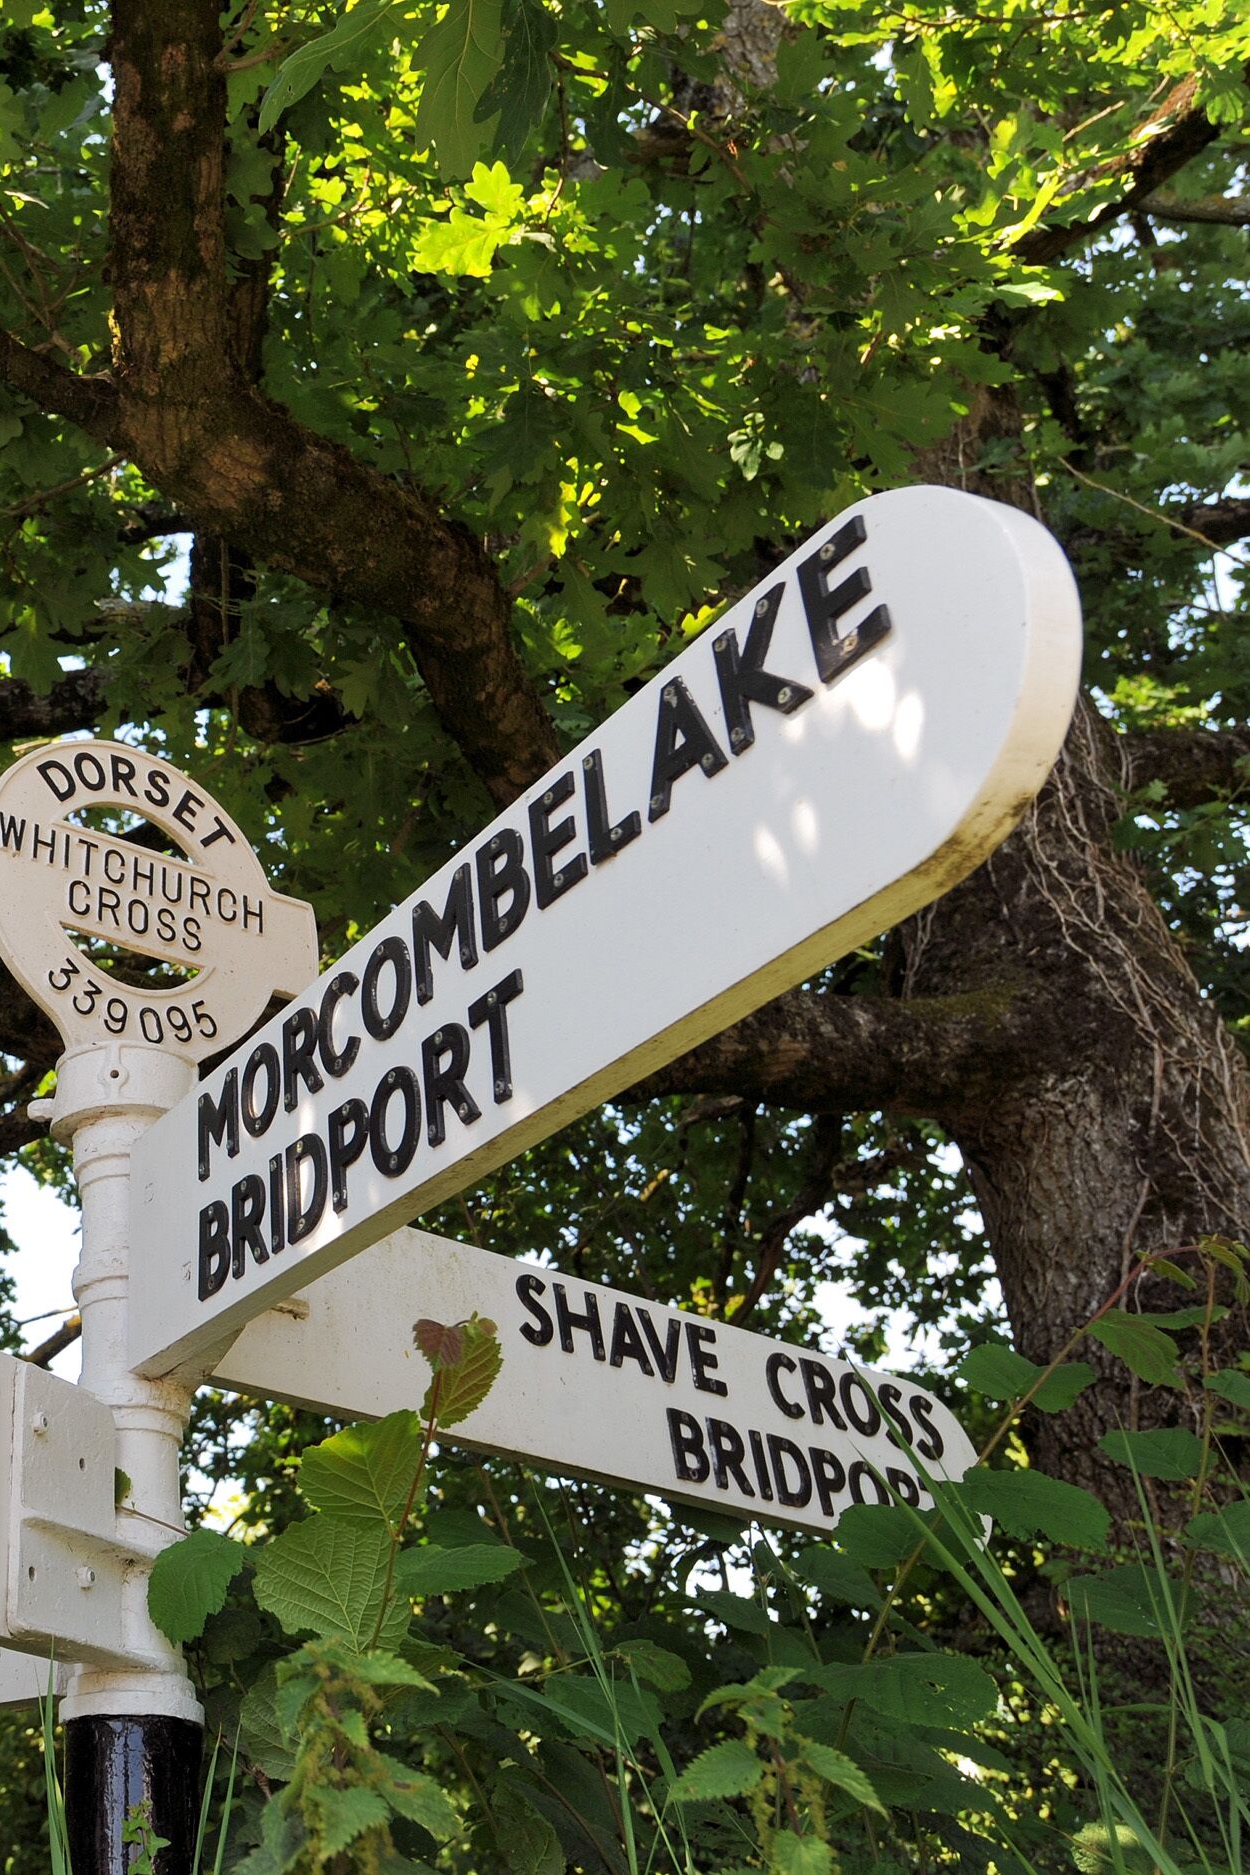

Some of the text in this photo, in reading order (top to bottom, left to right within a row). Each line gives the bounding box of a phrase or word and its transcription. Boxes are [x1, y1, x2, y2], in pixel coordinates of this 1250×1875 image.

[36, 751, 236, 851] DORSET
[198, 515, 892, 1181] MORCOMBELAKE
[0, 811, 264, 934] WHITCHURCH
[68, 880, 203, 951] CROSS
[47, 957, 218, 1045] 339095
[197, 968, 524, 1302] BRIDPORT
[515, 1273, 945, 1461] SHAVE CROSS
[666, 1407, 930, 1517] BRIDPOR
